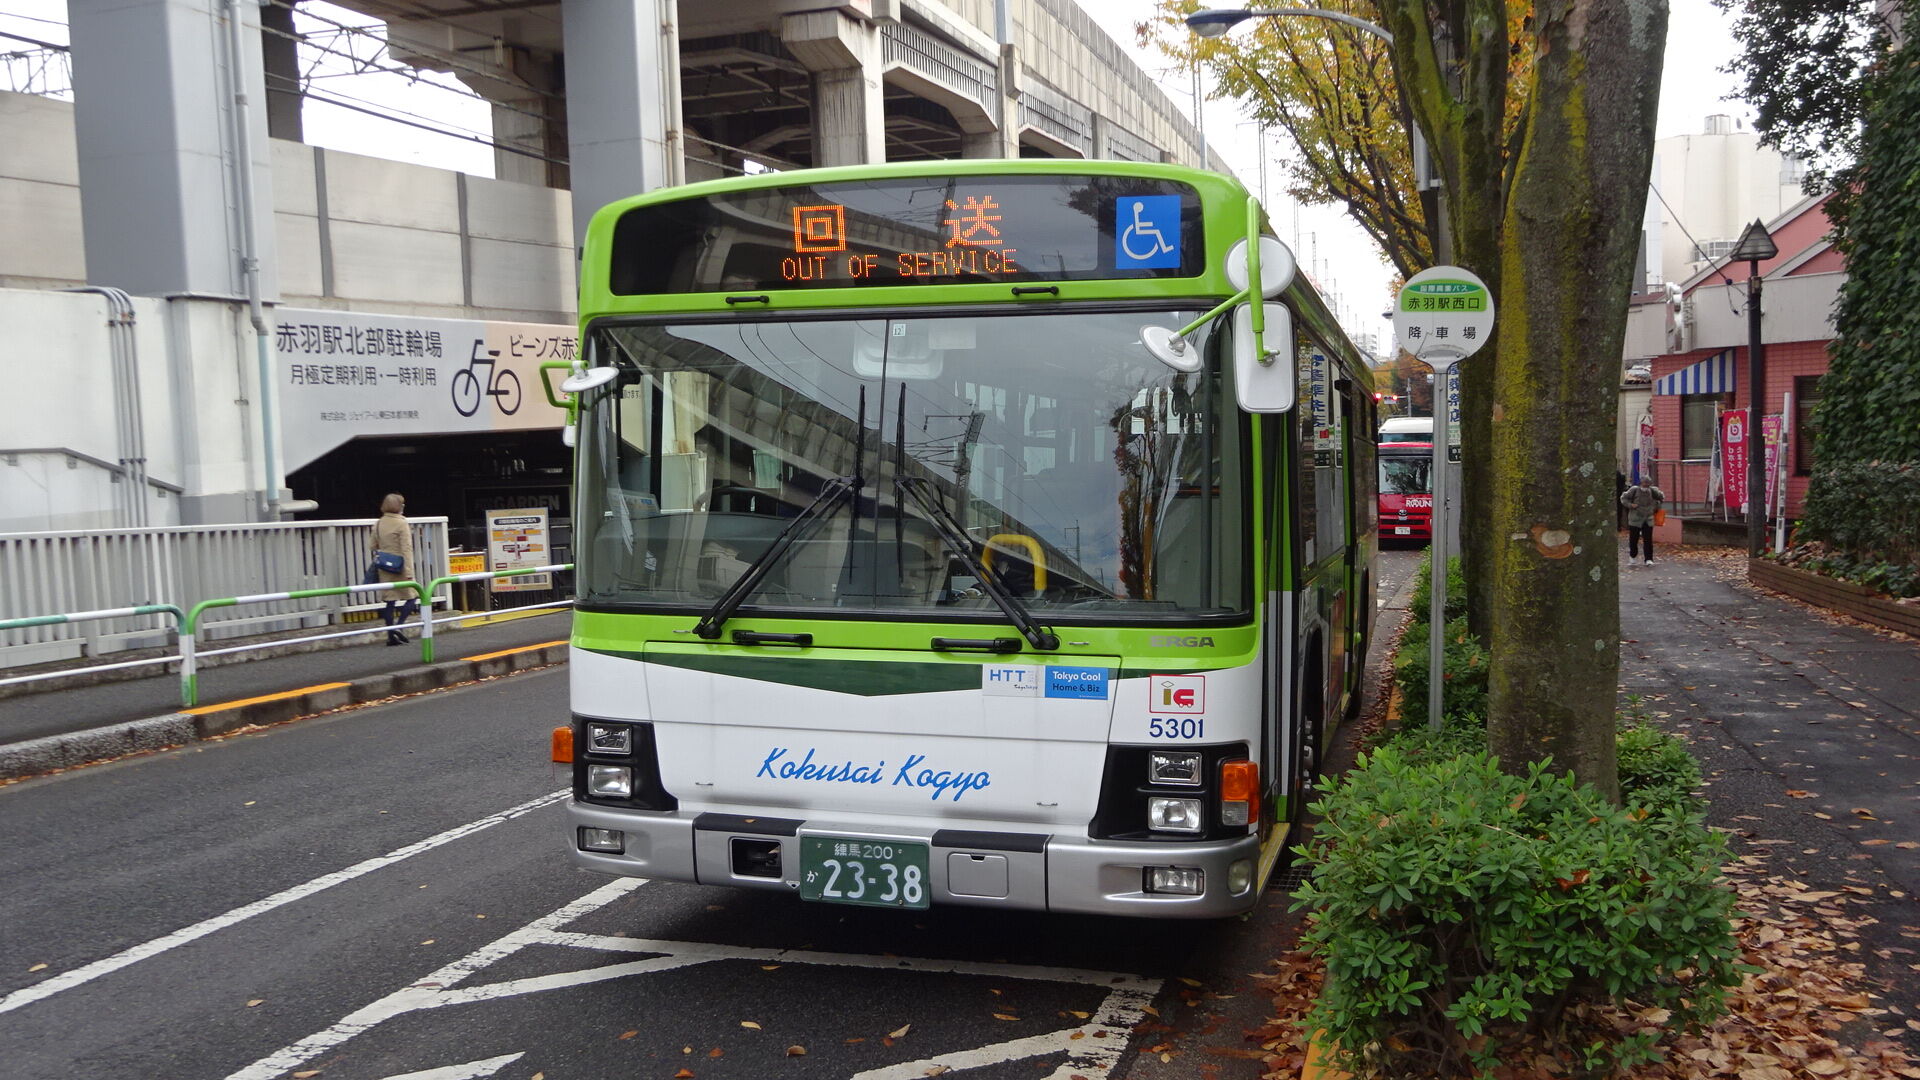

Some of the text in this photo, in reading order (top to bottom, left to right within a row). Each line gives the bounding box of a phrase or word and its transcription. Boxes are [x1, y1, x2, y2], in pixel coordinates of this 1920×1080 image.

[783, 248, 1017, 280] OUT OF SERVICE
[1408, 297, 1480, 309] 赤羽駅西口
[276, 322, 442, 358] 赤羽駅北部駐輪場
[1408, 326, 1476, 340] 降車場
[291, 364, 437, 386] 月極定期利用・一時利用
[1151, 636, 1215, 648] ERGA
[989, 669, 1026, 682] HTT
[1052, 671, 1101, 682] Tokyo Cool
[1052, 683, 1100, 692] Home & Biz
[1149, 718, 1204, 739] 5301
[756, 747, 991, 802] Kokusai Kogyo
[834, 843, 893, 860] 練馬 200
[806, 870, 819, 883] か
[823, 859, 923, 903] 23-38
